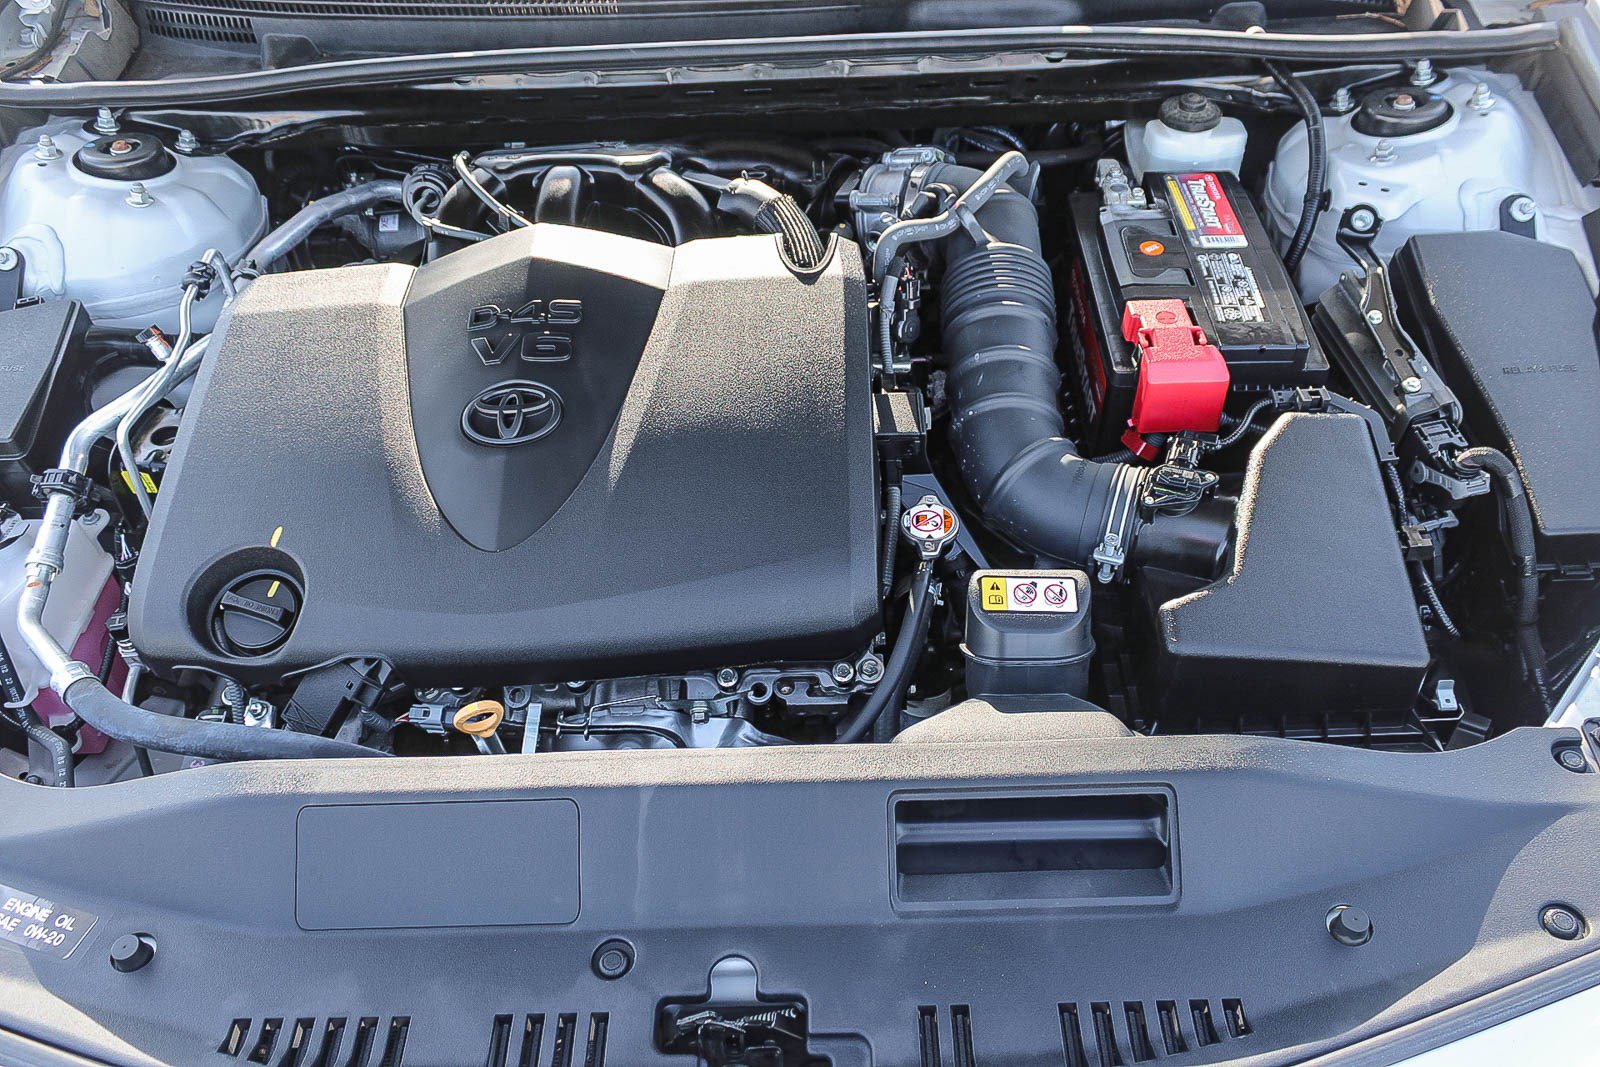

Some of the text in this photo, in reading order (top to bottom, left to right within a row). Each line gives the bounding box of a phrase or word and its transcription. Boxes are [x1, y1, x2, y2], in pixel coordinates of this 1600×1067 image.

[1187, 179, 1223, 230] TRUESTART
[1208, 181, 1222, 200] TOYOTA
[467, 299, 583, 331] D-4S
[470, 331, 573, 365] V6
[2, 897, 76, 931] ENGINE OIL
[23, 924, 65, 947] 0W-20
